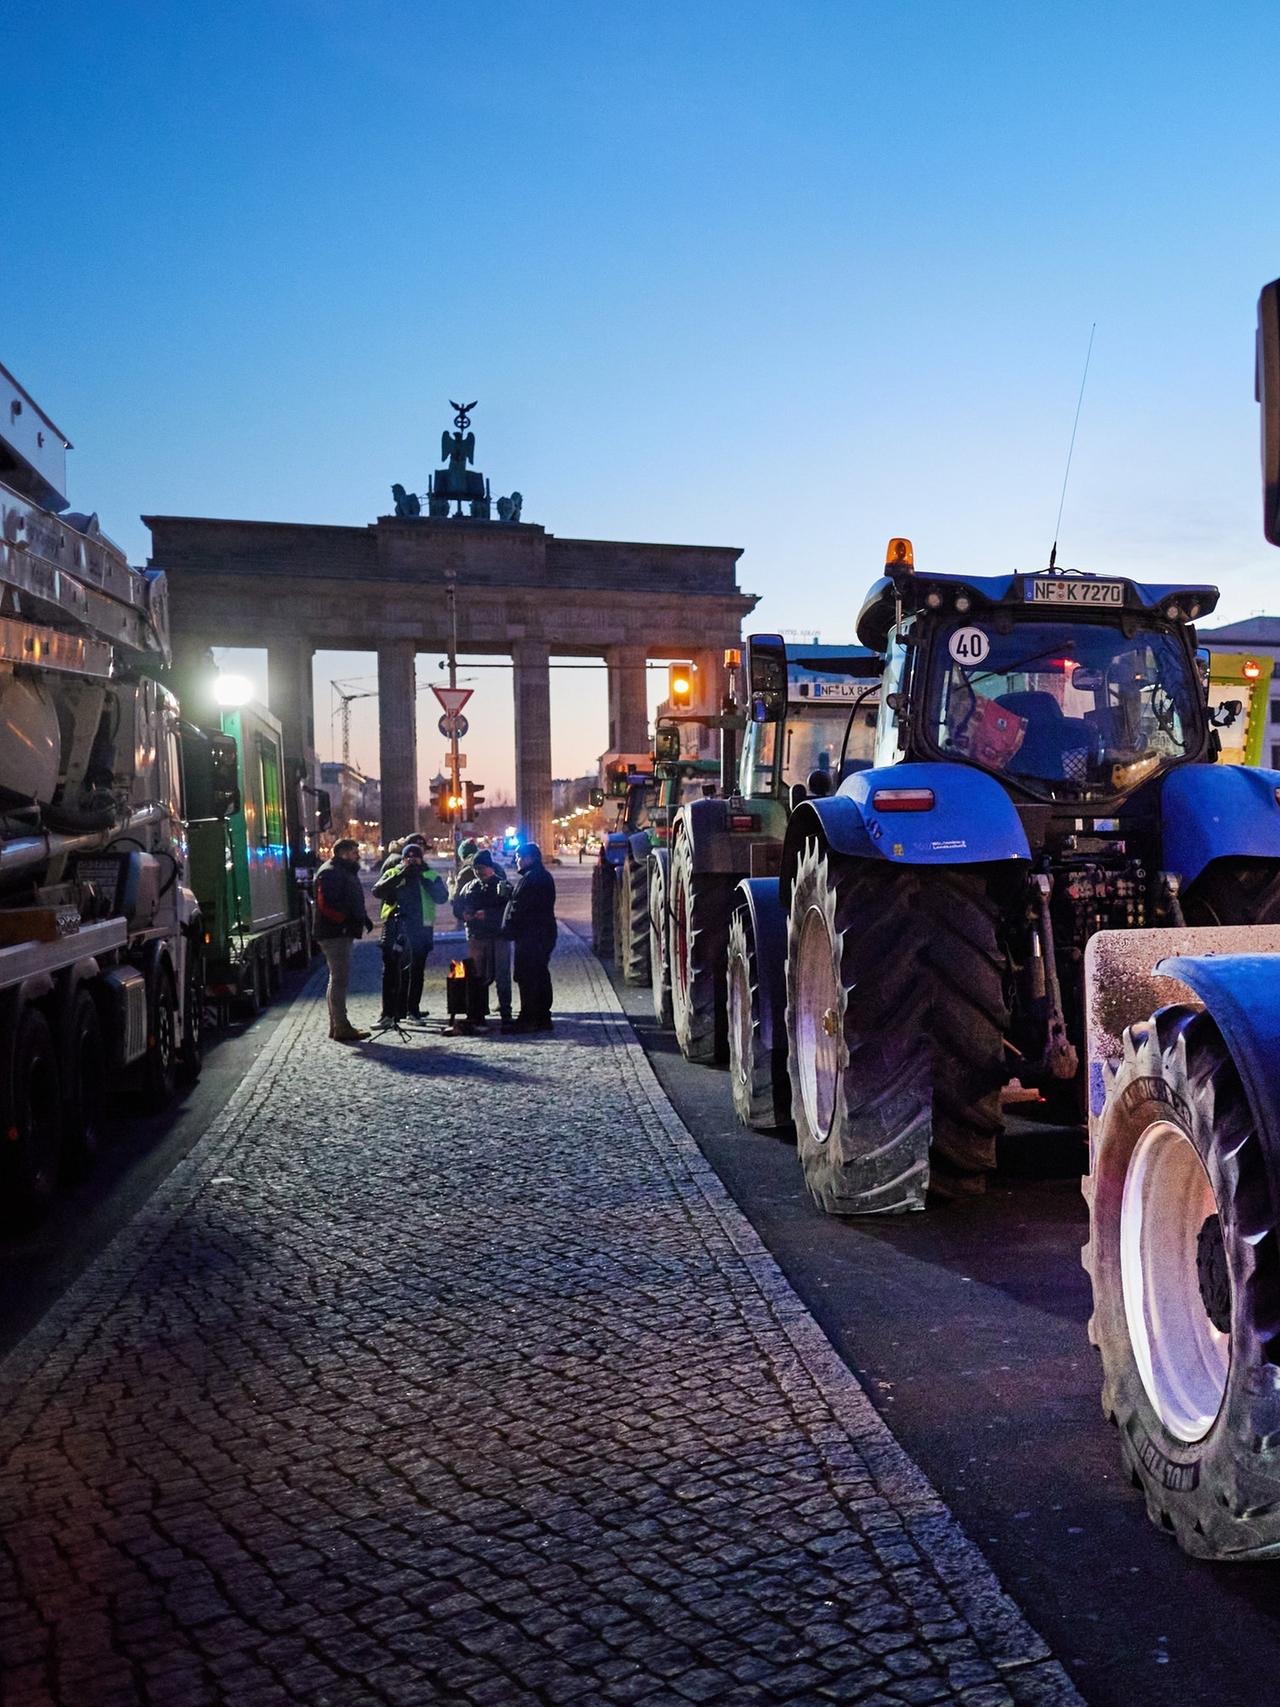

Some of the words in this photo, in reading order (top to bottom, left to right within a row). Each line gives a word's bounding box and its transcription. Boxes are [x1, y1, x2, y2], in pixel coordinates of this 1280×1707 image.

[1035, 582, 1057, 600] NF
[1067, 583, 1078, 601] K
[1081, 584, 1121, 602] 7270
[956, 634, 982, 658] 40
[821, 685, 834, 696] NF
[841, 685, 855, 696] LX
